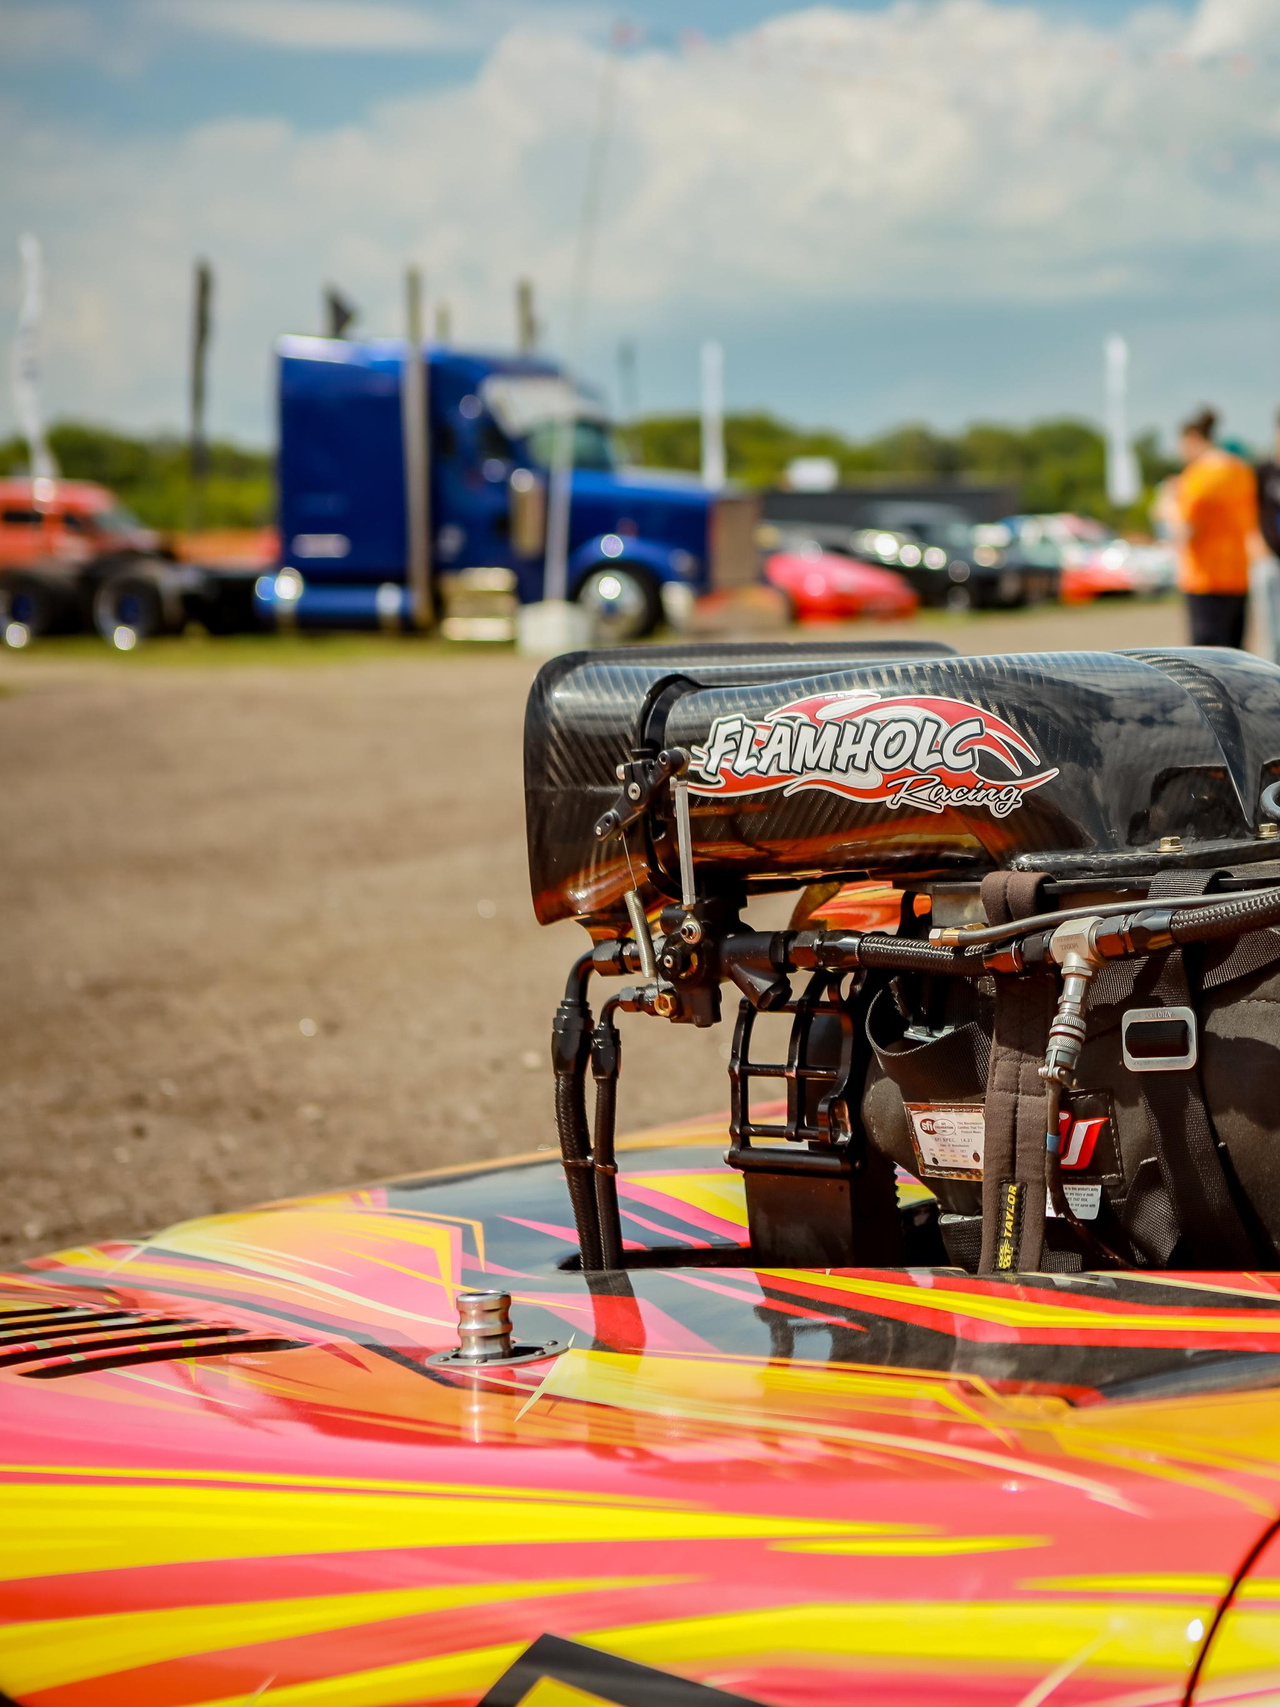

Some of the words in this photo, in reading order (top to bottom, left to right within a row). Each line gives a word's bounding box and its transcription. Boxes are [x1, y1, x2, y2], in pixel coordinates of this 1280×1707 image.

[705, 716, 984, 776] FLAMHOLC
[886, 774, 1022, 814] Racing
[1004, 1184, 1017, 1238] TAYLOR
